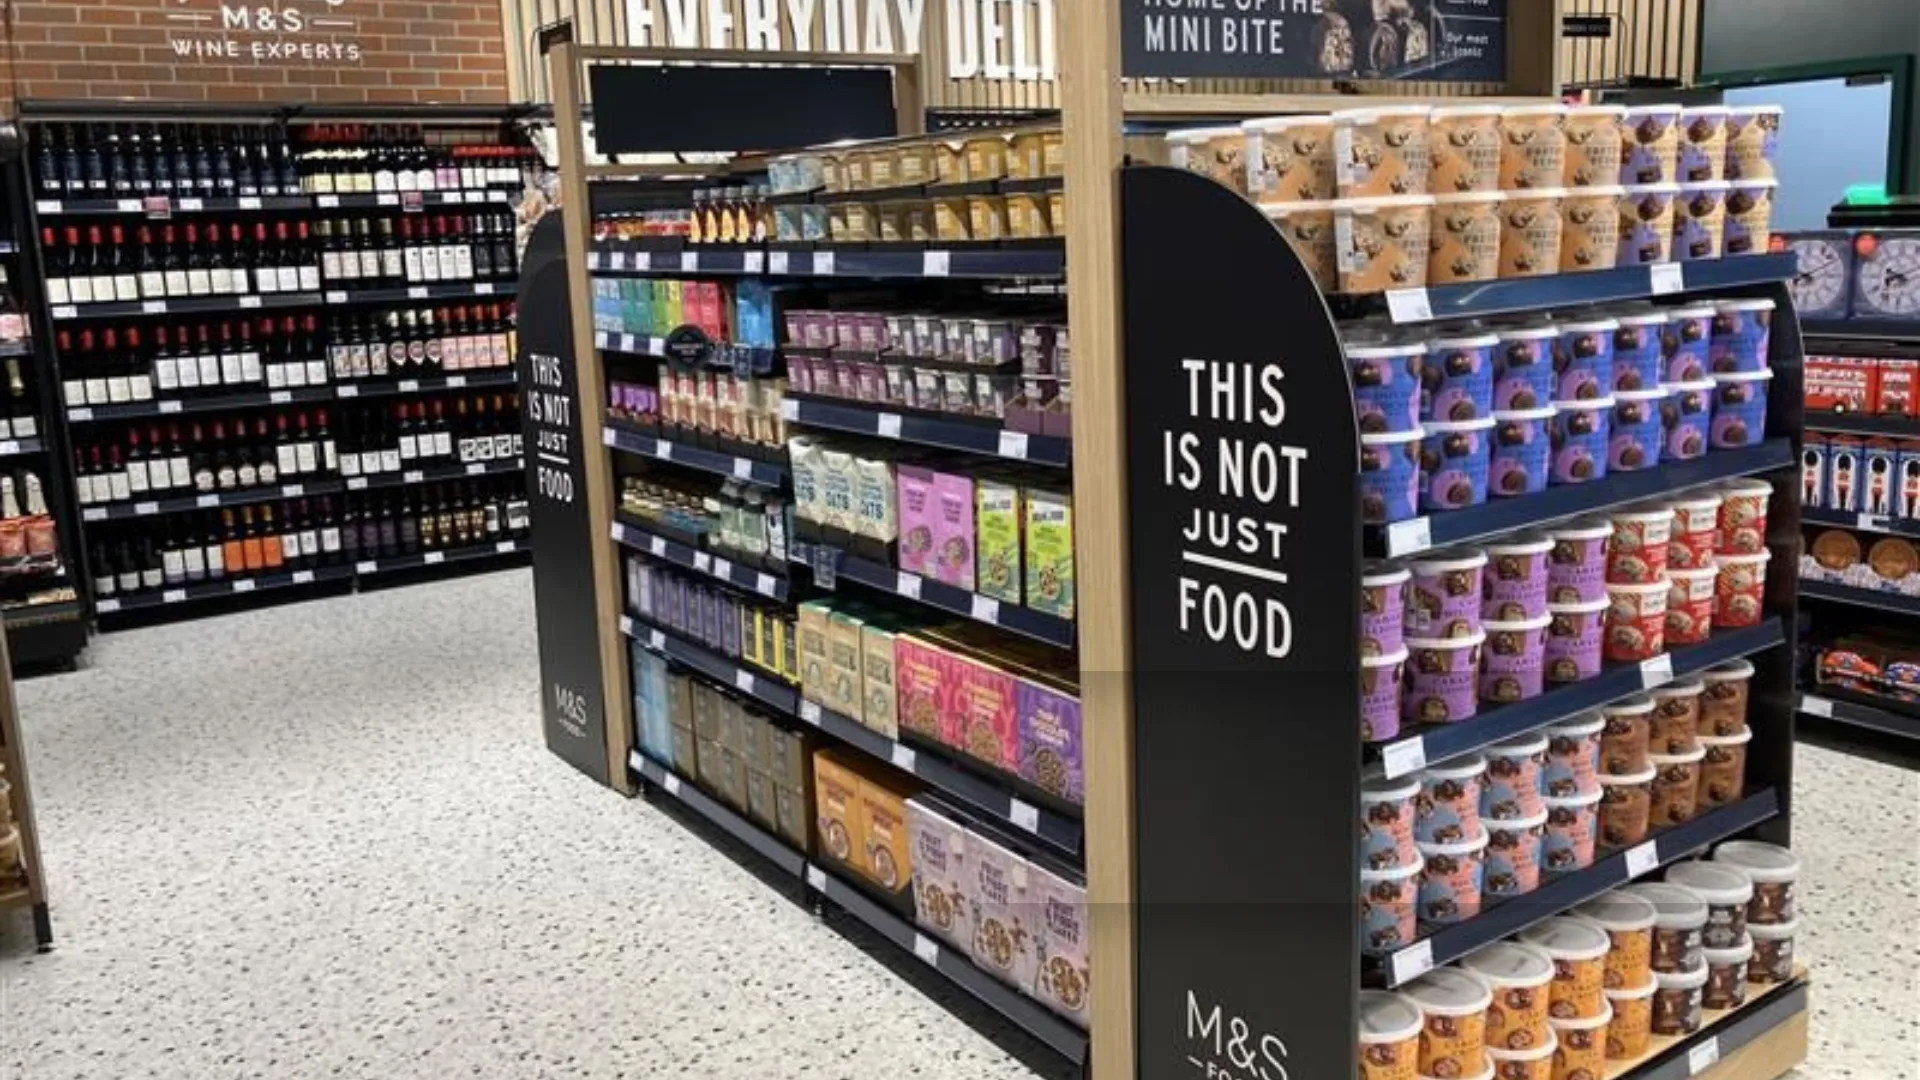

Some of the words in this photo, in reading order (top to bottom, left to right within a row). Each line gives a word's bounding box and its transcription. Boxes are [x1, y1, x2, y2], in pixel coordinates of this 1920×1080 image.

[220, 4, 303, 33] M&S
[1144, 14, 1211, 52] MINI
[1222, 17, 1284, 54] BITE
[171, 39, 240, 57] WINE
[250, 41, 361, 61] EXPERTS
[529, 353, 562, 388] THIS
[527, 389, 542, 421] IS
[543, 393, 570, 427] NOT
[1182, 358, 1286, 427] THIS
[536, 430, 568, 453] JUST
[537, 465, 574, 503] FOOD
[1164, 430, 1202, 491] IS
[1218, 438, 1308, 508] NOT
[1182, 507, 1288, 560] JUST
[1179, 576, 1293, 660] FOOD
[553, 682, 587, 725] M&S
[1187, 989, 1288, 1080] M&S
